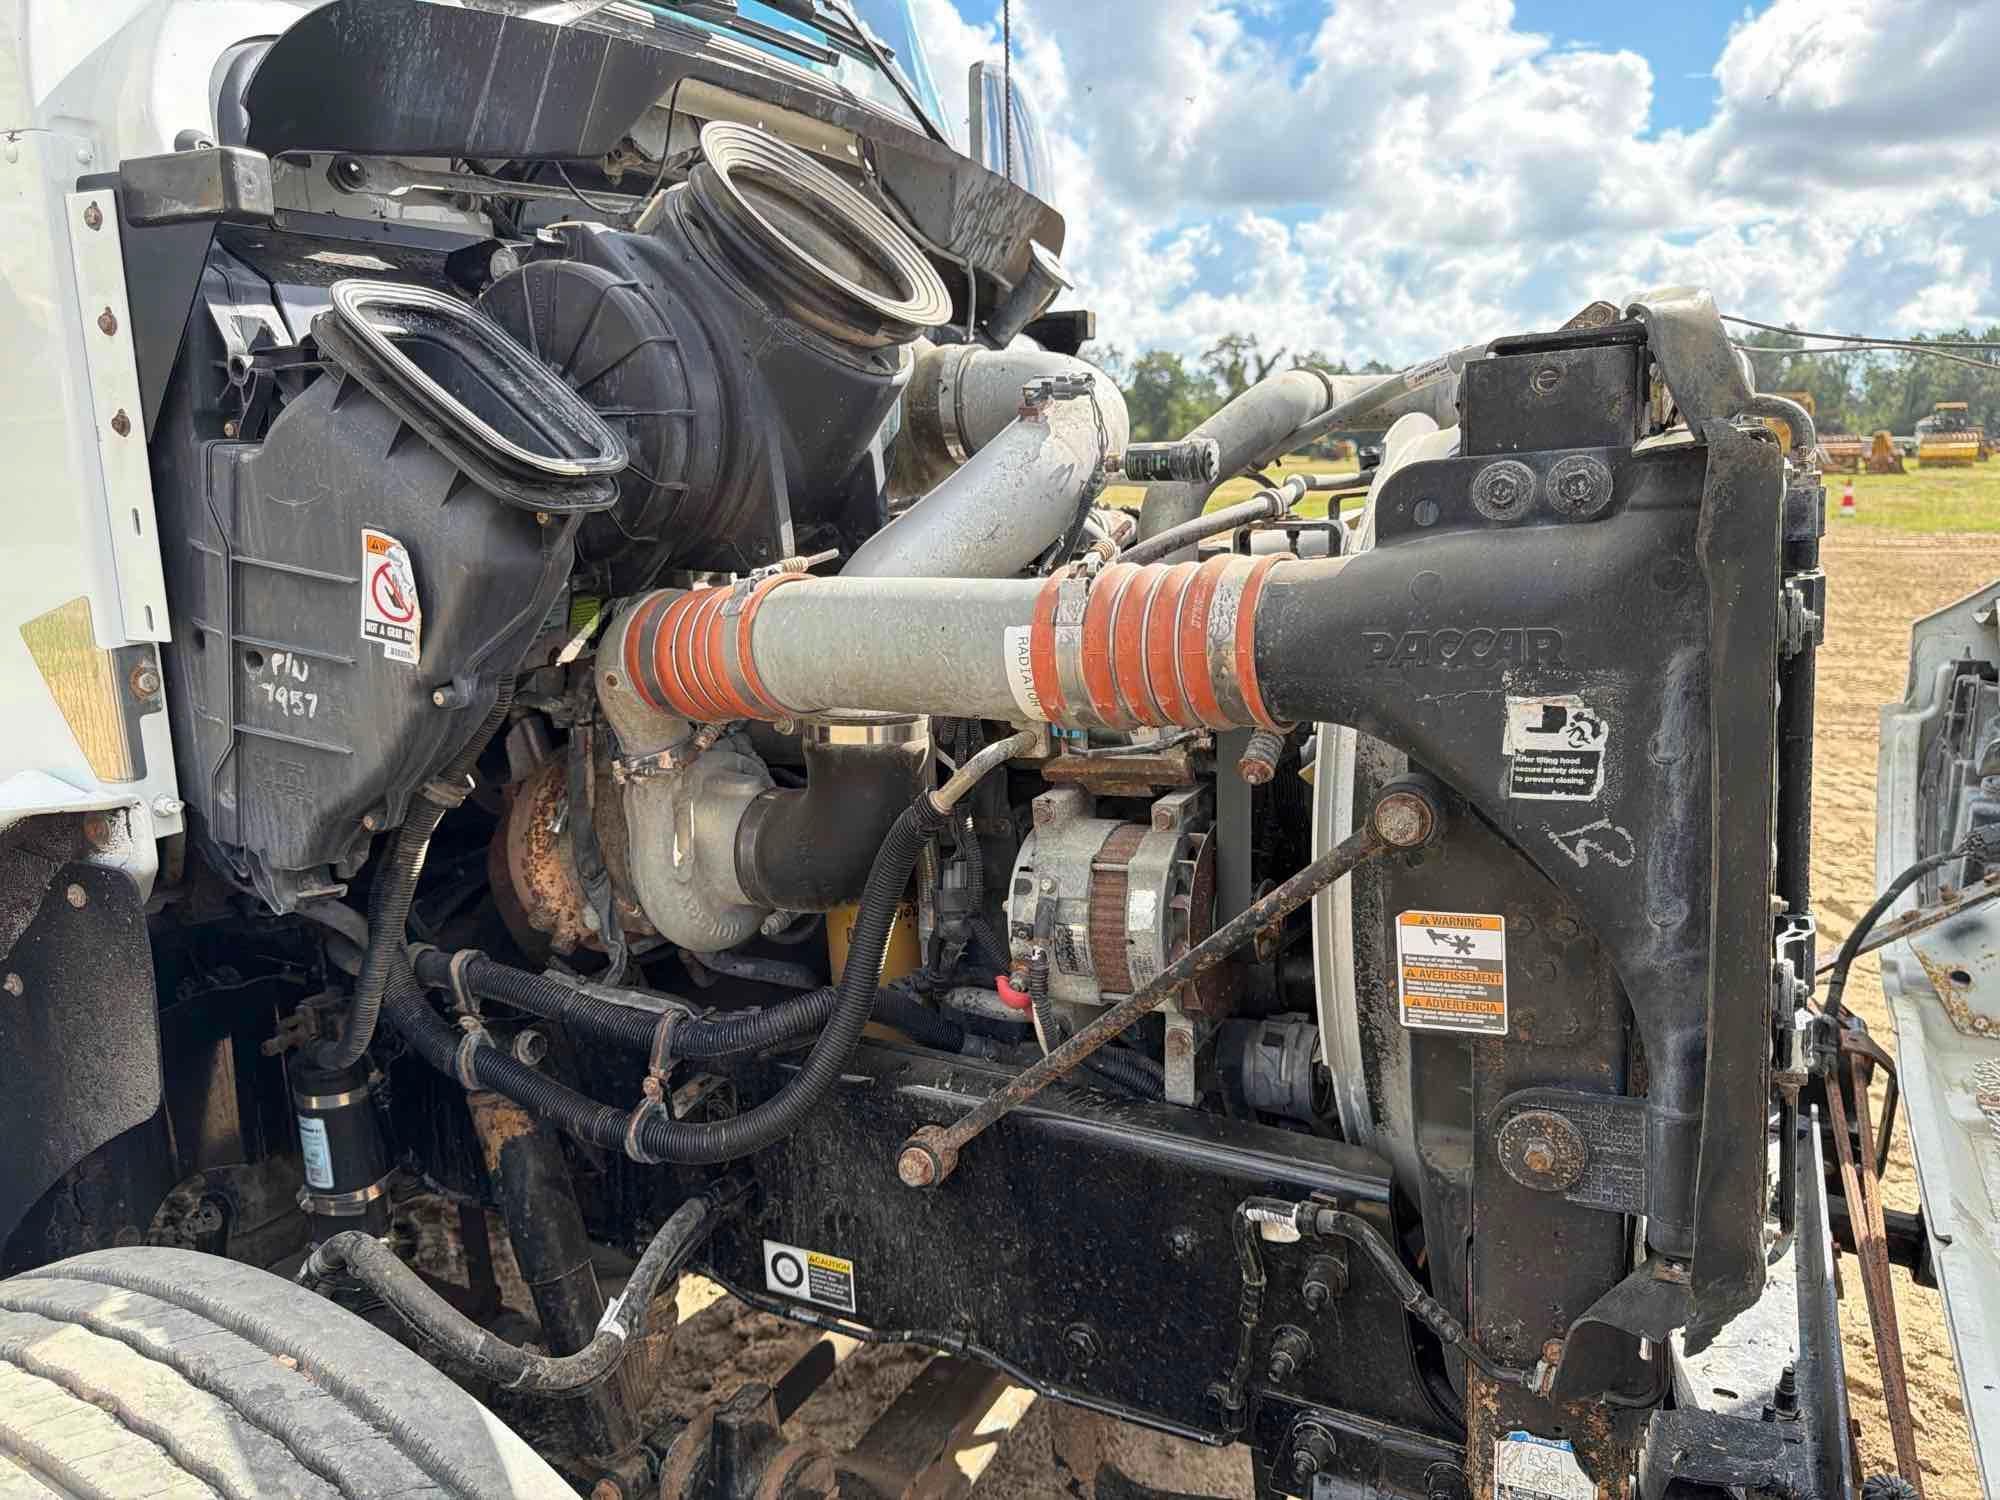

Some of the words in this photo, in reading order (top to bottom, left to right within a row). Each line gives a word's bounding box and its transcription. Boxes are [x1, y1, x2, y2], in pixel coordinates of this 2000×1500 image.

[1361, 626, 1567, 670] PACCAR
[1568, 767, 1594, 775] device
[1432, 915, 1482, 928] WARNING
[1420, 968, 1501, 983] AVERTISSEMENT
[1425, 999, 1497, 1012] ADVERTENCIA
[815, 1256, 850, 1271] CAUTION
